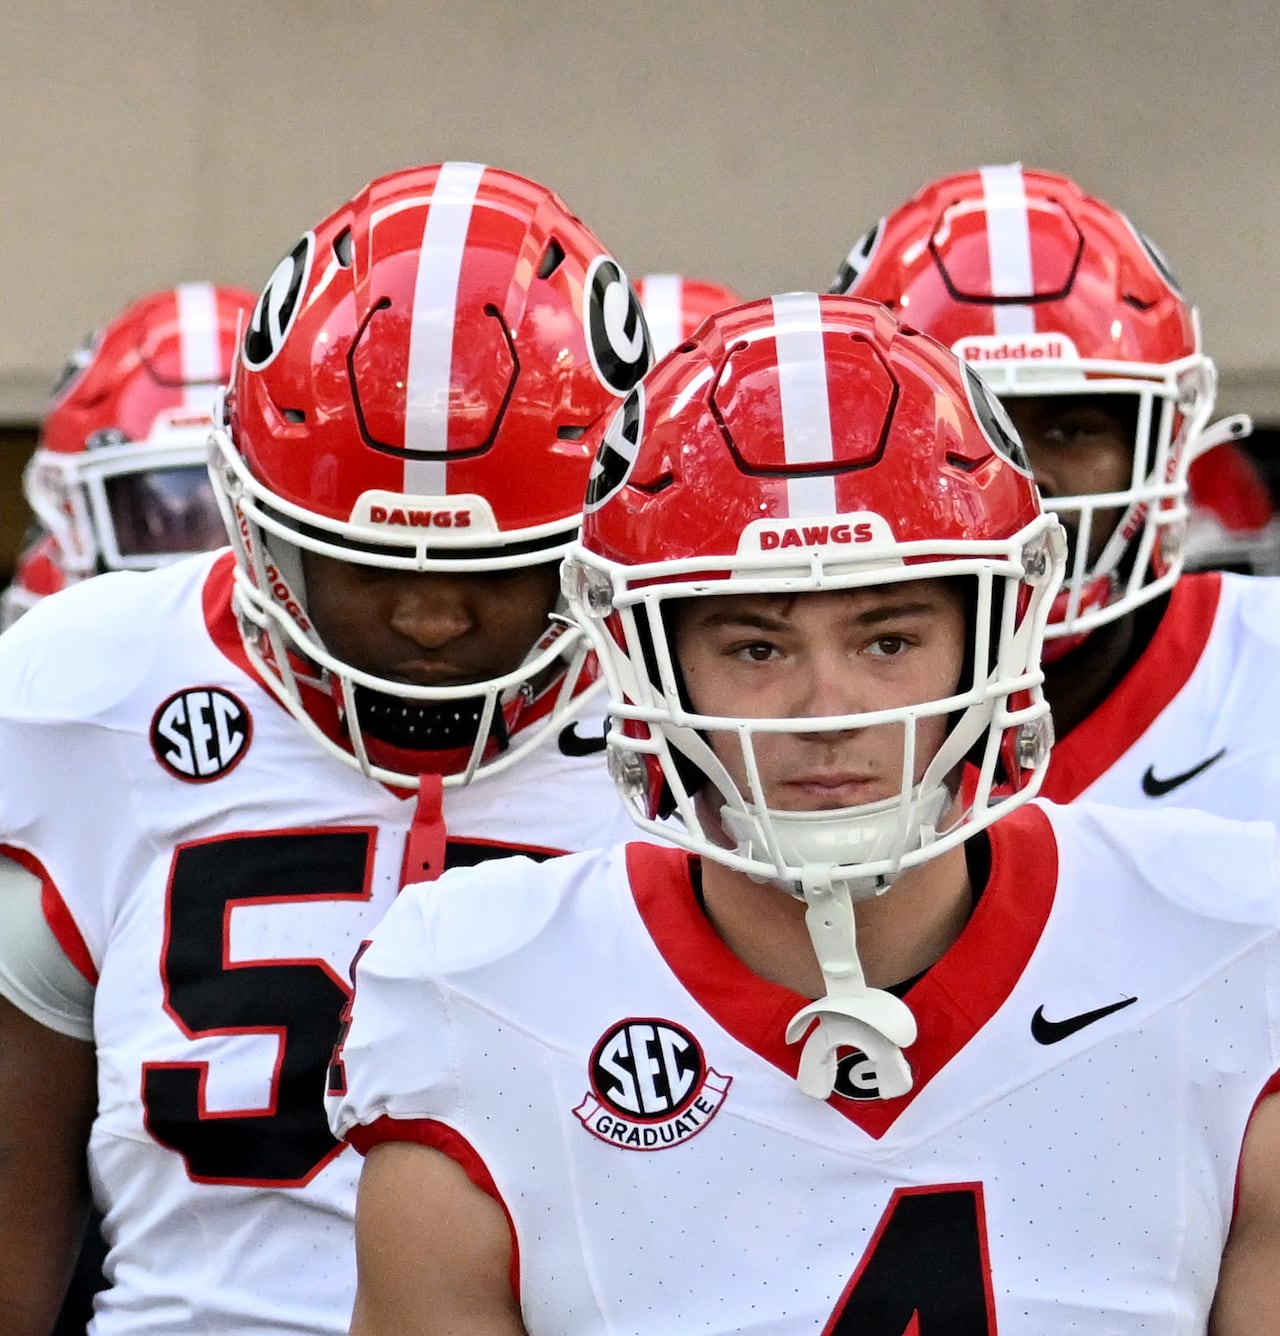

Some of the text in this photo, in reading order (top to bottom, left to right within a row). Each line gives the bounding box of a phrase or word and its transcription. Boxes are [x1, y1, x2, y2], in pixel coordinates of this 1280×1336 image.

[963, 342, 1062, 361] Riddell
[369, 507, 471, 529] DAWGS
[760, 523, 873, 551] DAWGS
[160, 690, 245, 779] SEC
[598, 1024, 696, 1114] SEC
[595, 1096, 715, 1147] GRADUATE
